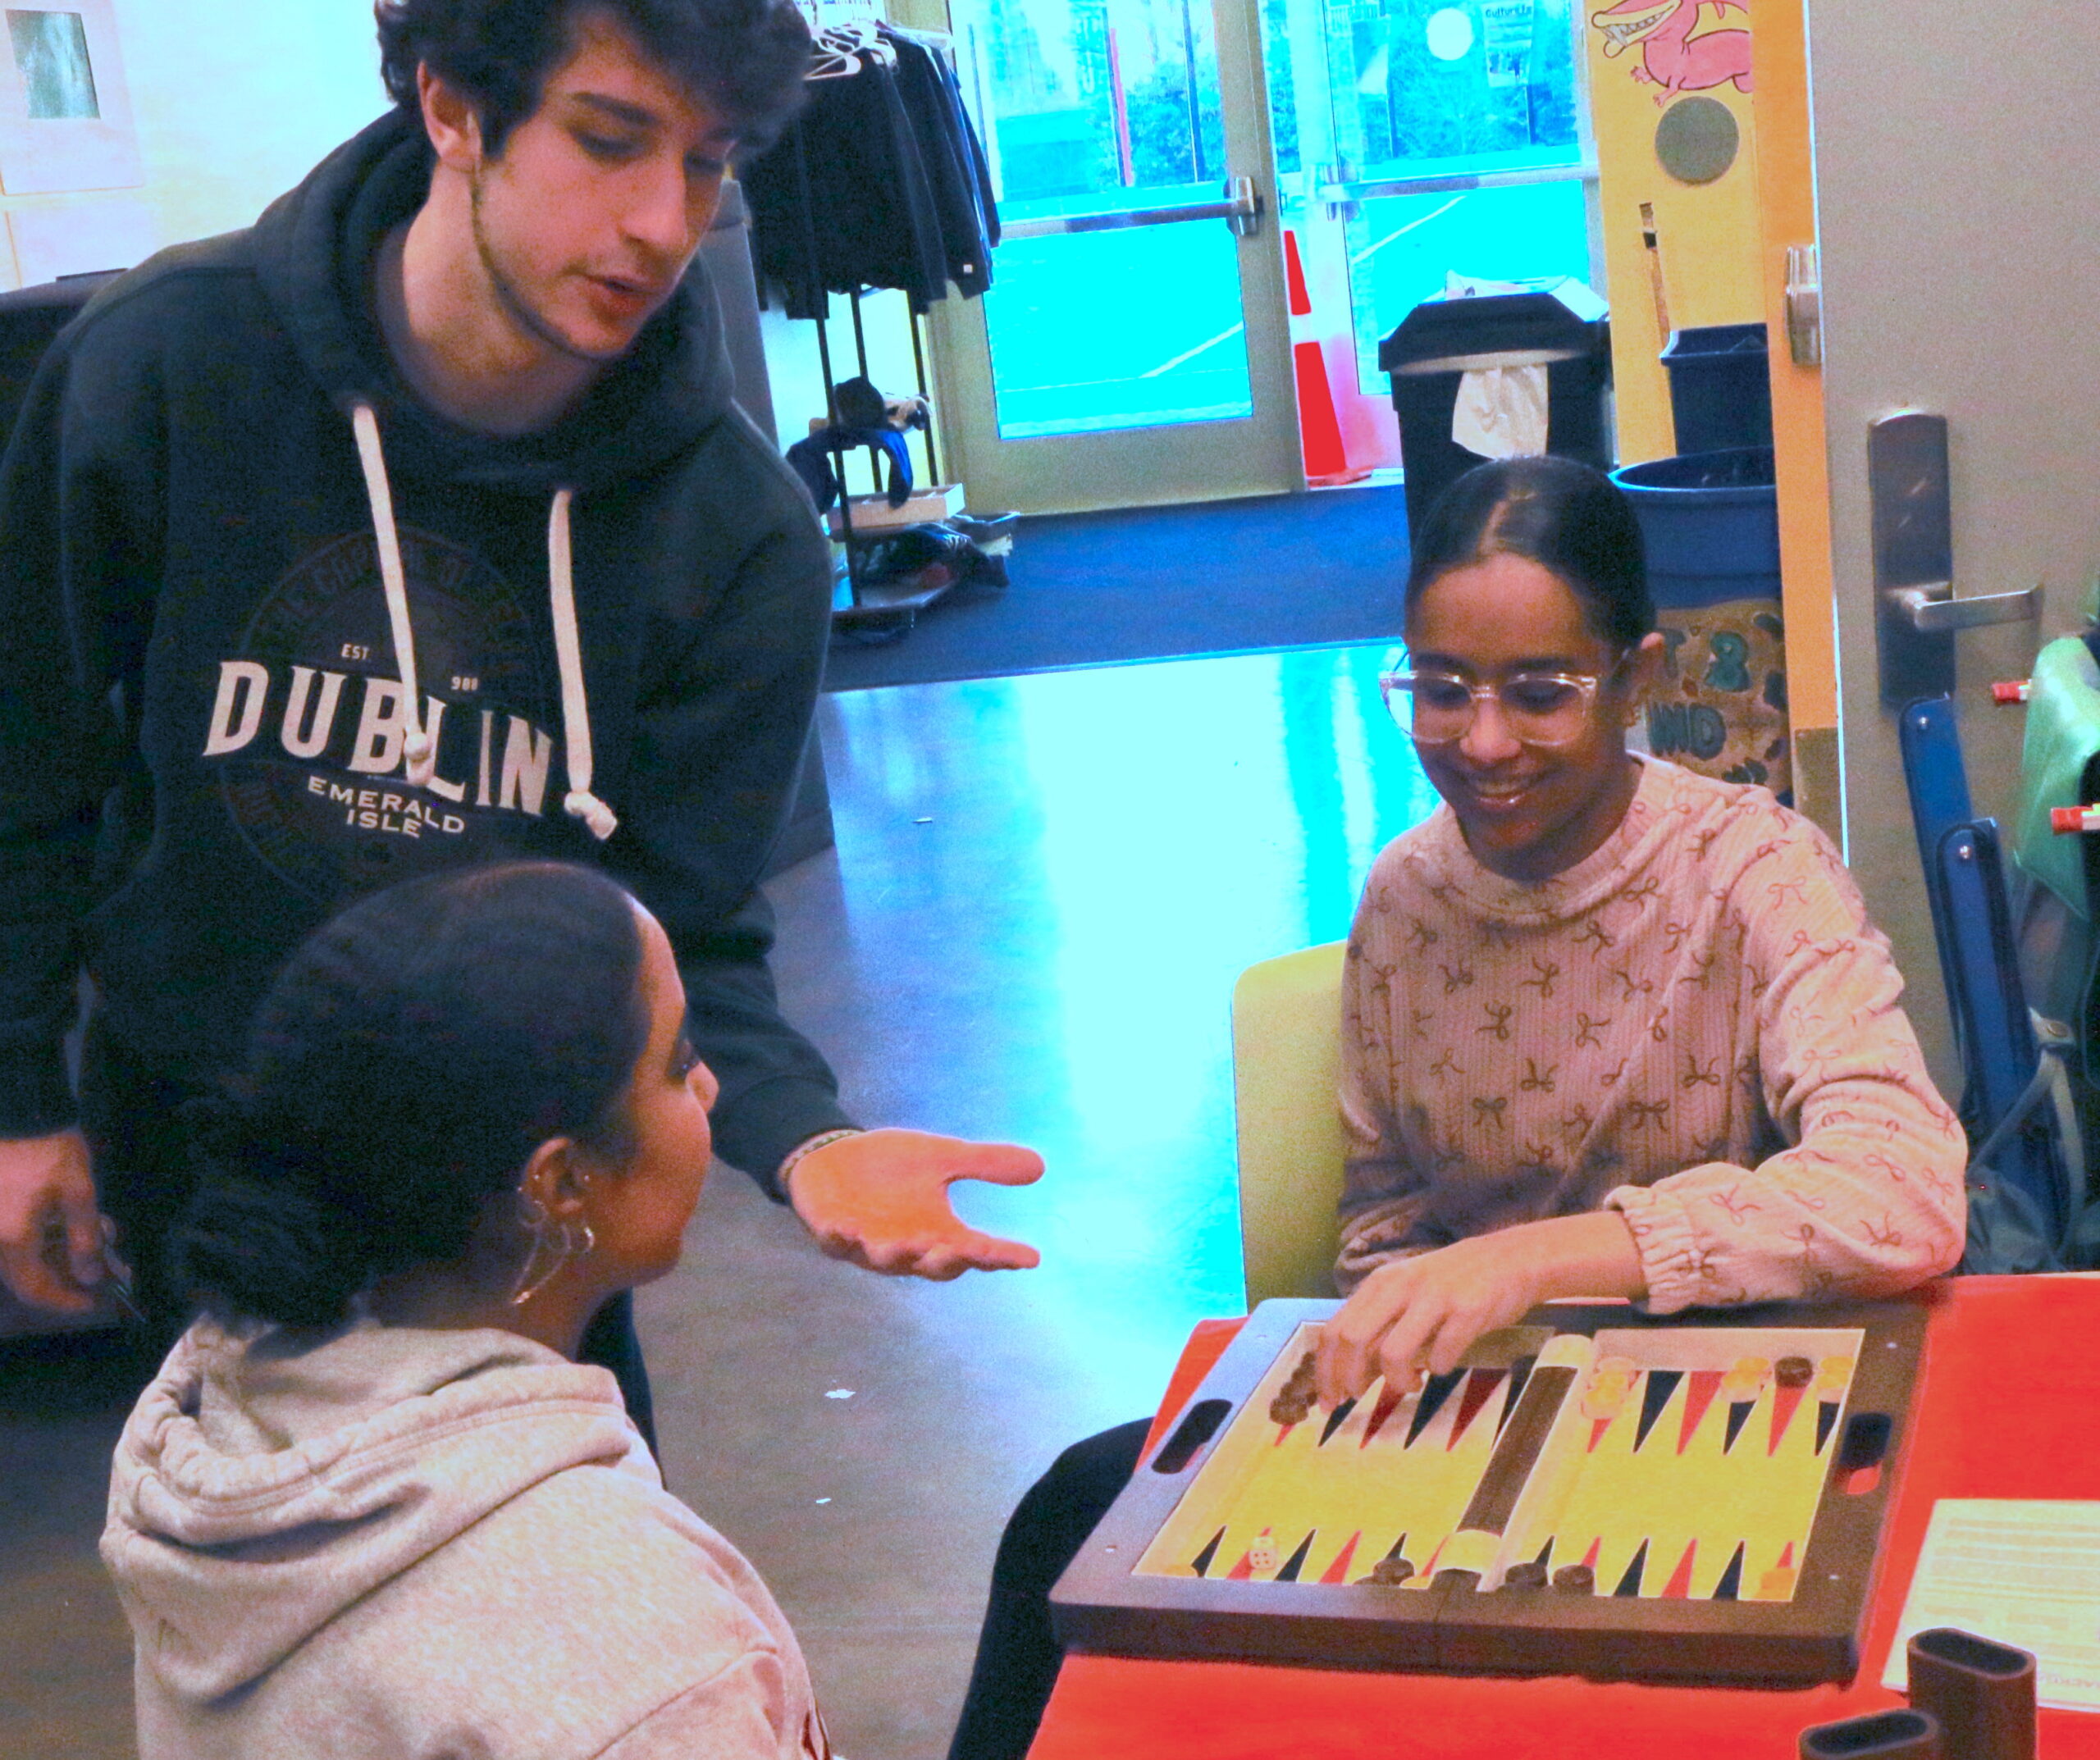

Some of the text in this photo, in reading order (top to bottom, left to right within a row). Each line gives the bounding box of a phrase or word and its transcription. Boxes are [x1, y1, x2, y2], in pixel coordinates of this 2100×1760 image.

[202, 660, 553, 817] DUBLIN
[308, 775, 465, 834] EMERALD
[346, 809, 422, 839] ISLE
